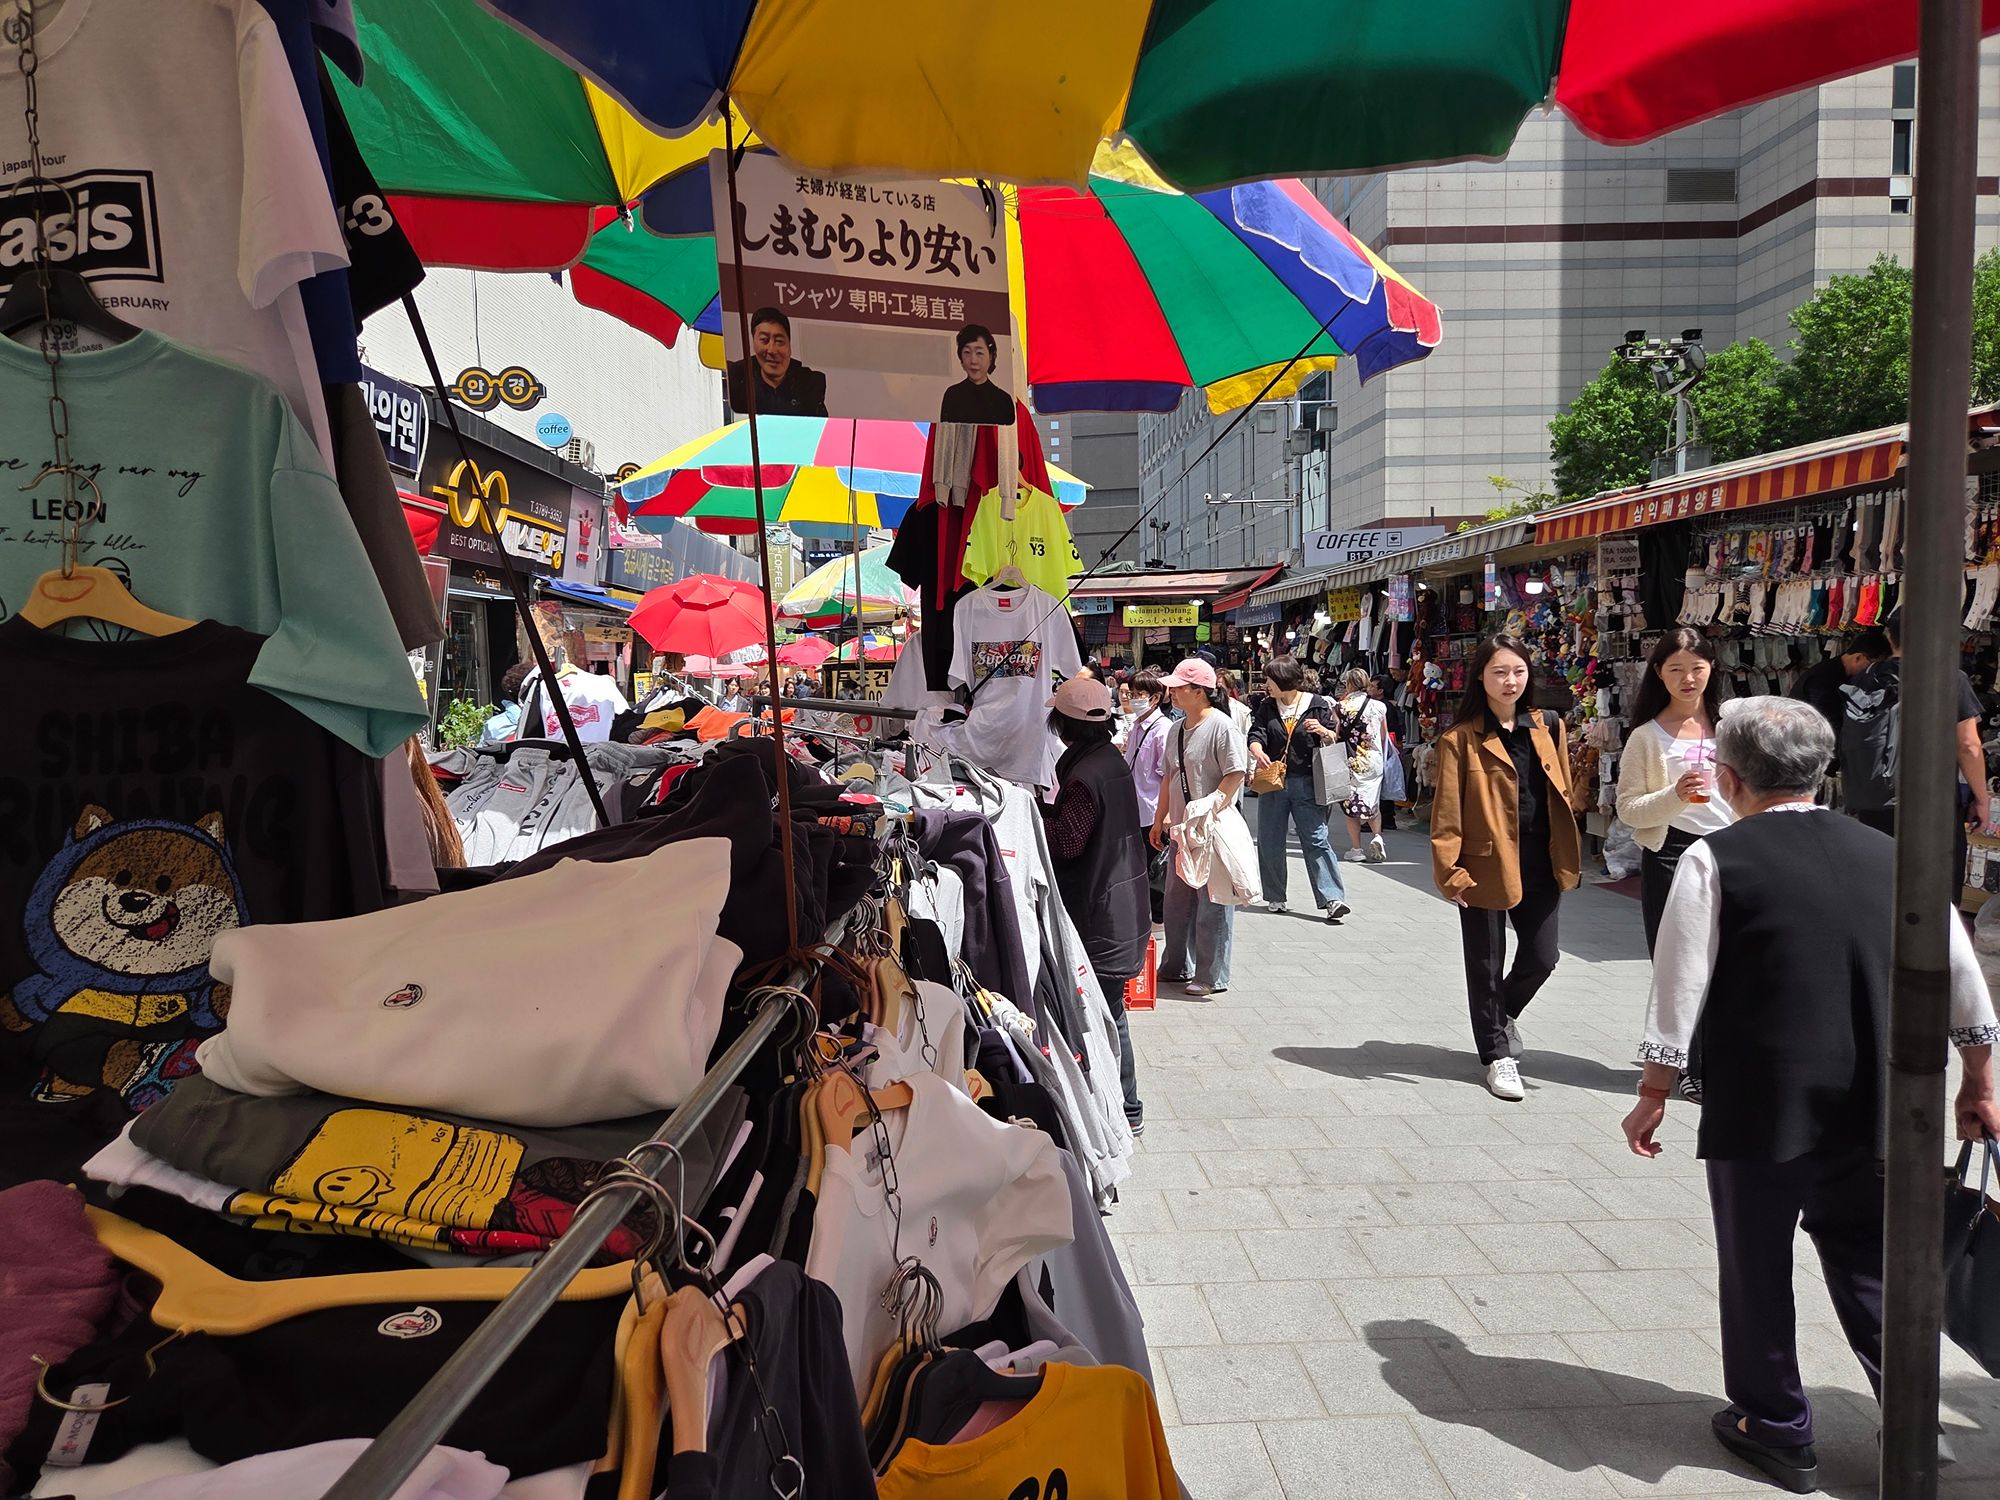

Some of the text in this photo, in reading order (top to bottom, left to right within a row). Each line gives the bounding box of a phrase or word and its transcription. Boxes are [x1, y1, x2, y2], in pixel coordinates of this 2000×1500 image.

[41, 154, 67, 167] tour
[795, 176, 936, 212] 夫婦が経営している店
[737, 201, 996, 277] しまむらより安い
[774, 281, 844, 309] Tシャツ
[81, 343, 104, 353] OASIS
[538, 424, 569, 435] coffee
[168, 469, 206, 497] way
[32, 498, 107, 524] LEON
[1633, 487, 1724, 523] 삼익패션양말
[450, 533, 494, 554] BEST OPTICAL
[501, 520, 565, 570] 베스트안경
[1316, 532, 1381, 550] COFFEE
[774, 552, 783, 588] COFFEE
[1129, 616, 1192, 624] いらっしゃいませ
[36, 703, 236, 776] SHIBA
[430, 1126, 448, 1143] DGT
